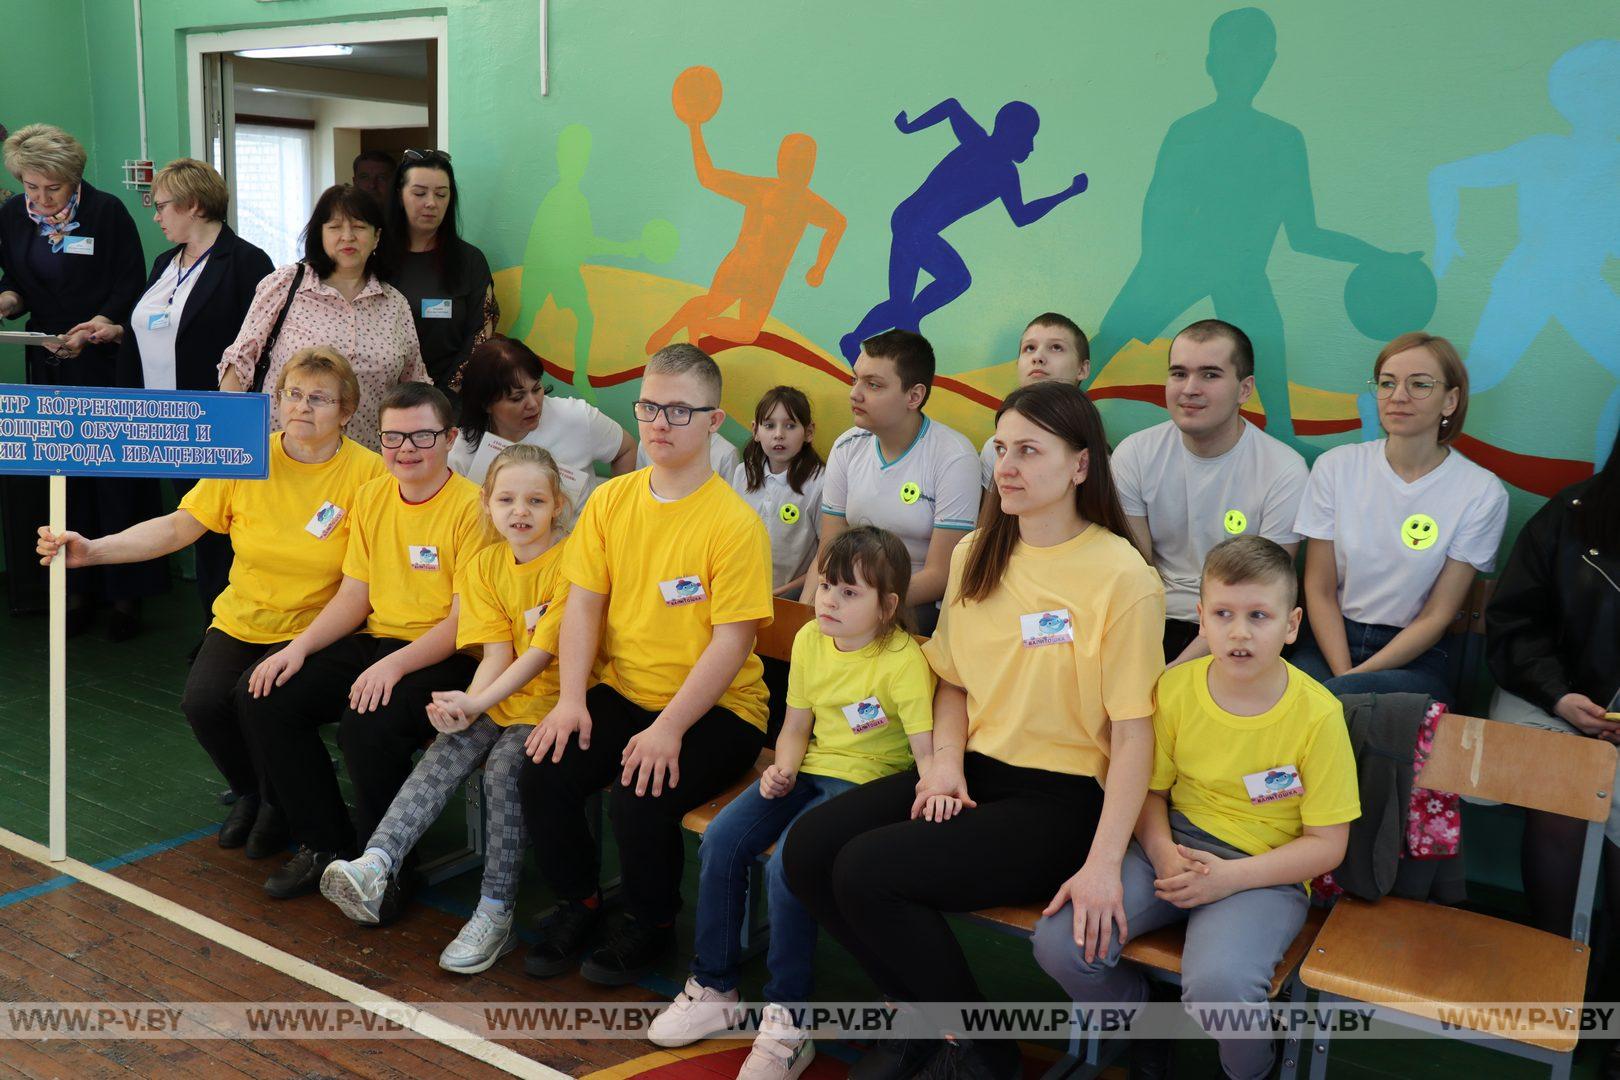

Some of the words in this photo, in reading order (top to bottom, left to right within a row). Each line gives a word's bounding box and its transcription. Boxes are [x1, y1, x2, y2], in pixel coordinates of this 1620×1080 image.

[37, 396, 206, 421] КОРРЕКЦИОННО-
[81, 420, 189, 441] ОБУЧЕНИЯ
[196, 424, 211, 442] И
[33, 442, 115, 466] ГОРОДА
[122, 445, 254, 467] ИВАЦЕВИЧИ»
